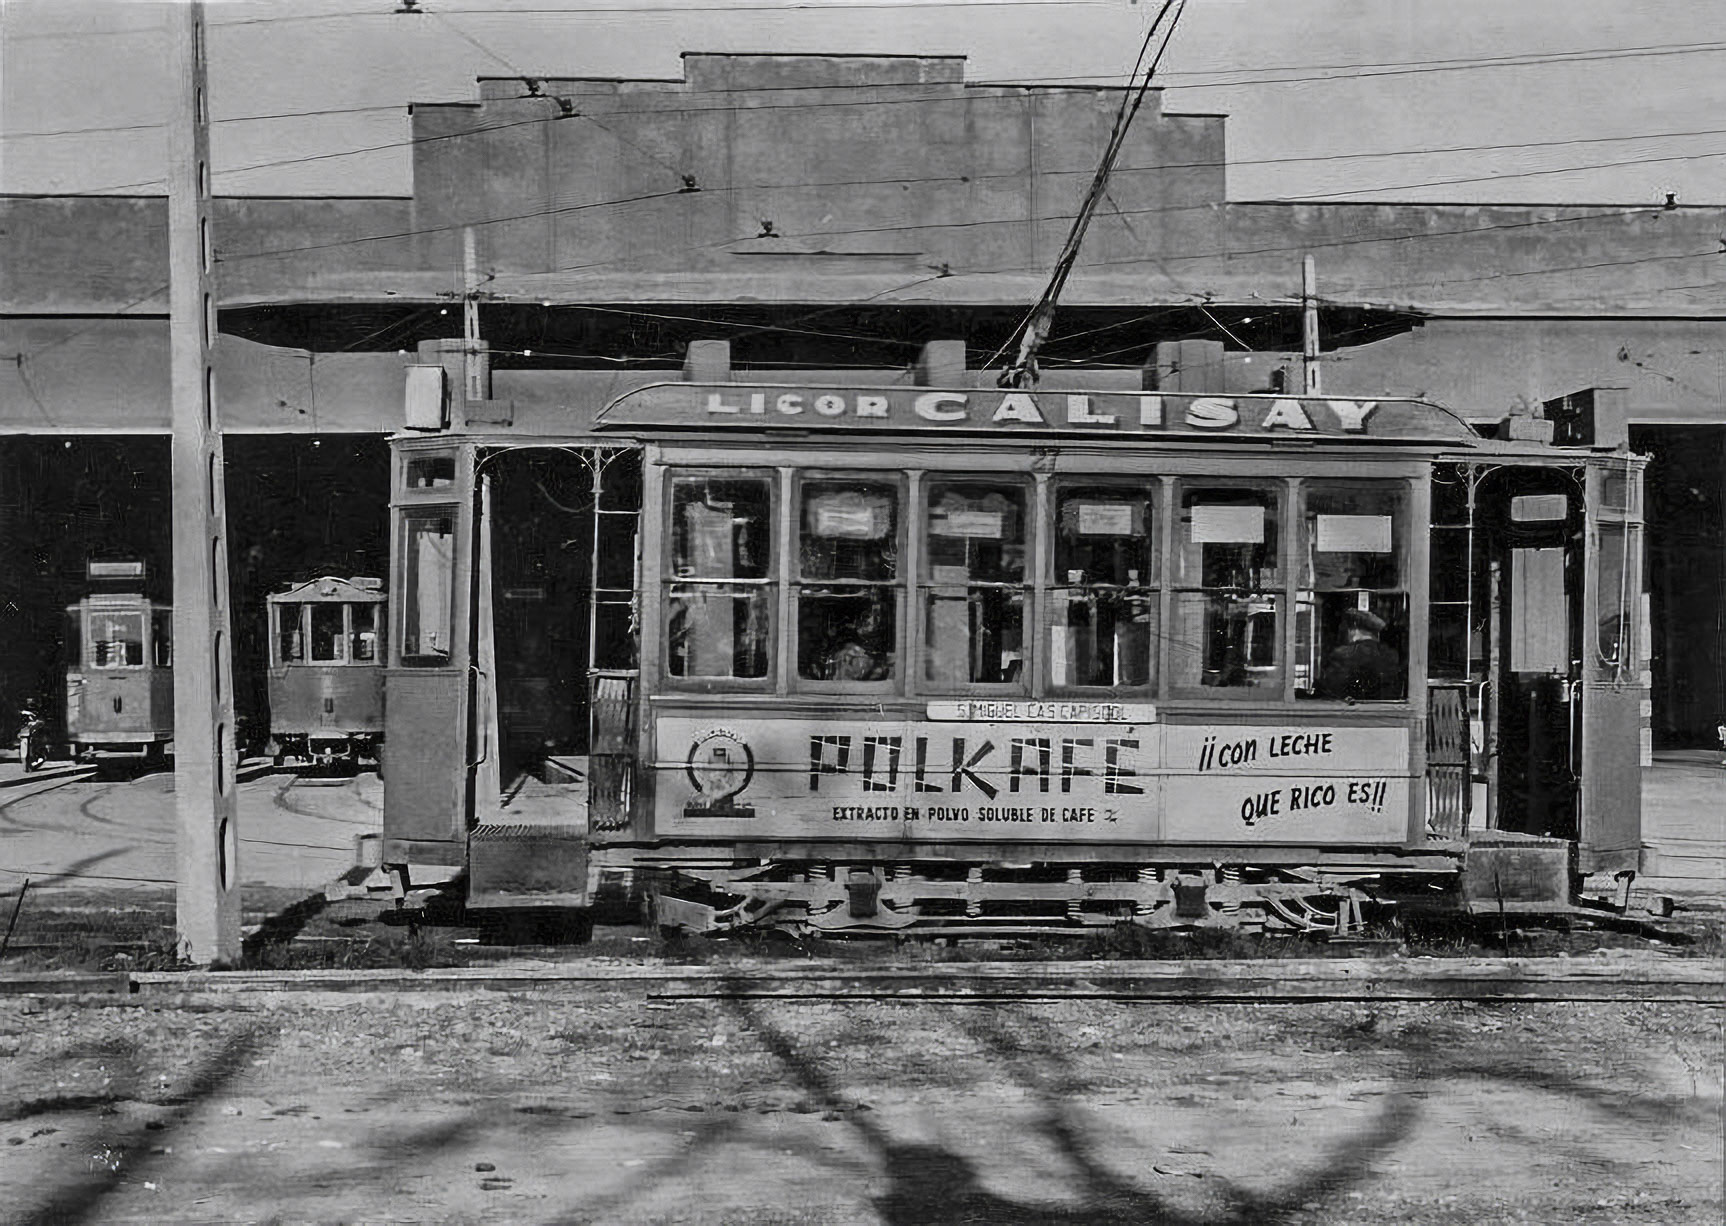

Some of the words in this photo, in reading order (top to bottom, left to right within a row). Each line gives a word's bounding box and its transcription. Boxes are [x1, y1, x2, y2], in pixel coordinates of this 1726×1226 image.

[707, 393, 889, 417] LICOR
[914, 392, 1377, 434] CALISAY
[1269, 733, 1333, 758] LECHE
[809, 736, 1145, 800] POLKAFE
[832, 806, 899, 822] EXTRACTO
[903, 807, 919, 821] EN
[928, 807, 969, 822] POLVO
[977, 807, 1033, 822] SOLUBLE
[1041, 807, 1056, 822] DE
[1062, 807, 1096, 822] CAFE
[1241, 790, 1281, 826] QUE
[1289, 785, 1335, 811] RICO
